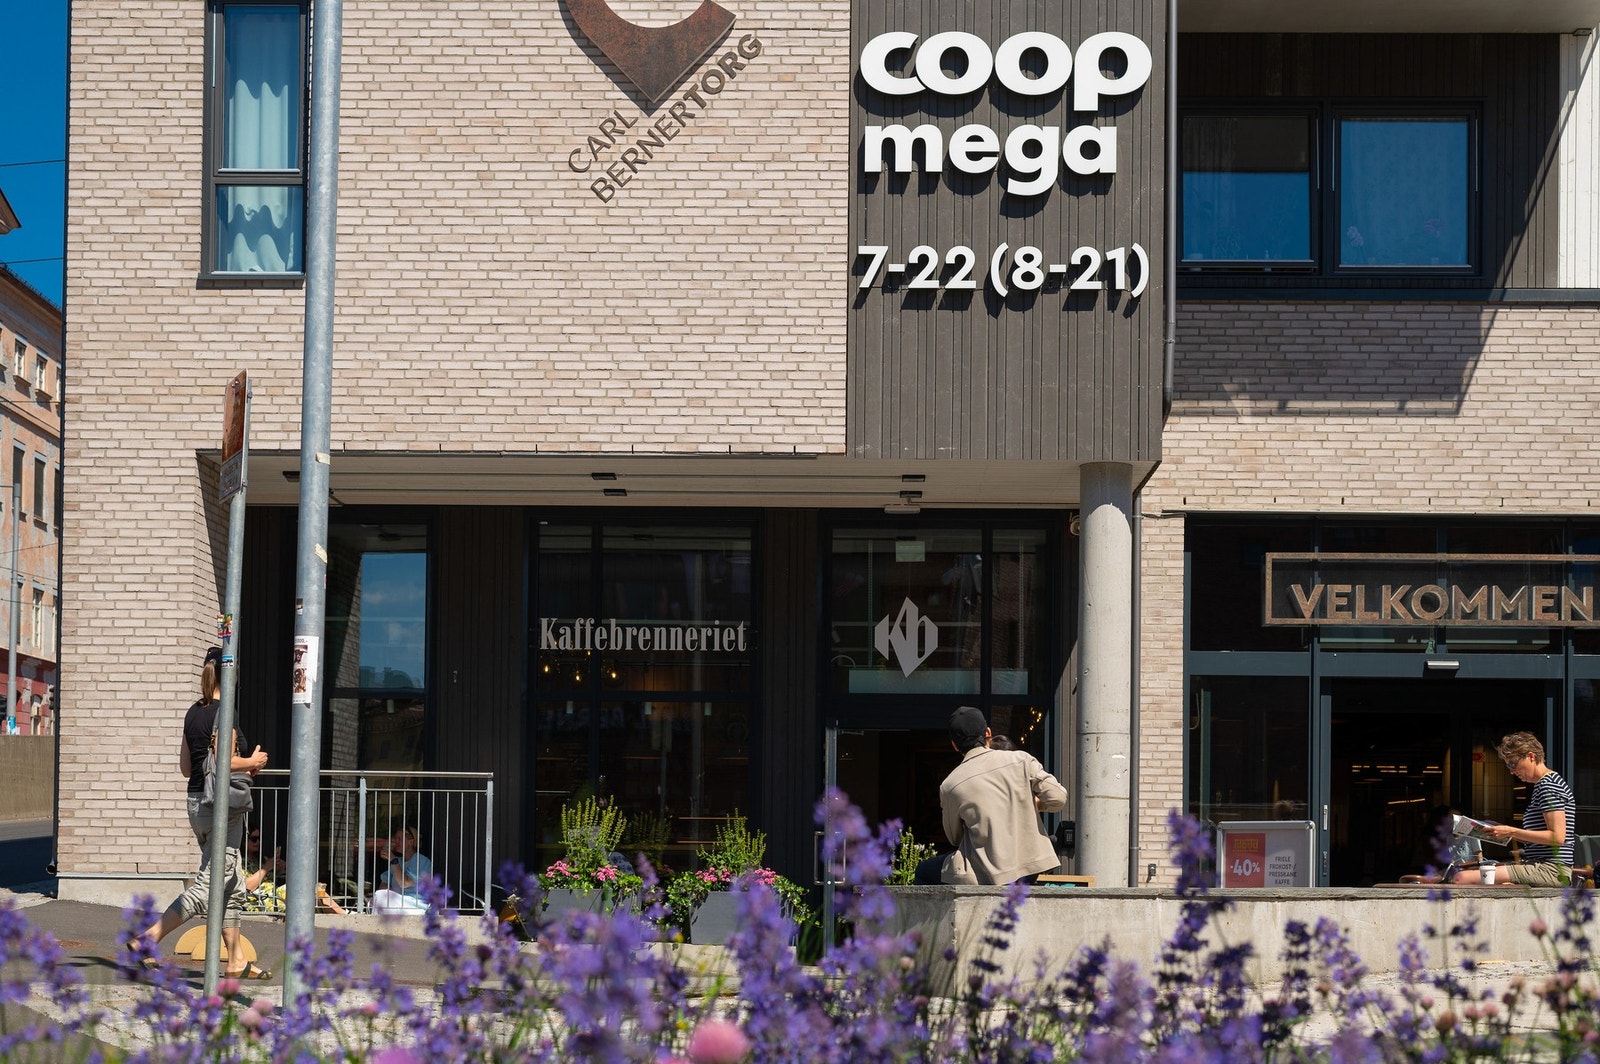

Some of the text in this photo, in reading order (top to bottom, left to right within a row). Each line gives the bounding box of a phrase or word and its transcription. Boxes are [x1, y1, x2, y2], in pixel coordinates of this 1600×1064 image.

[860, 31, 1152, 111] coop
[568, 110, 638, 173] CARL
[590, 34, 762, 203] BERNERTORG
[864, 124, 1117, 196] mega
[858, 242, 1149, 297] 7-22 (8-21)
[1289, 584, 1594, 622] VELKOMMEN
[539, 617, 747, 652] Kaffebrenneriet
[1230, 859, 1261, 877] -40%
